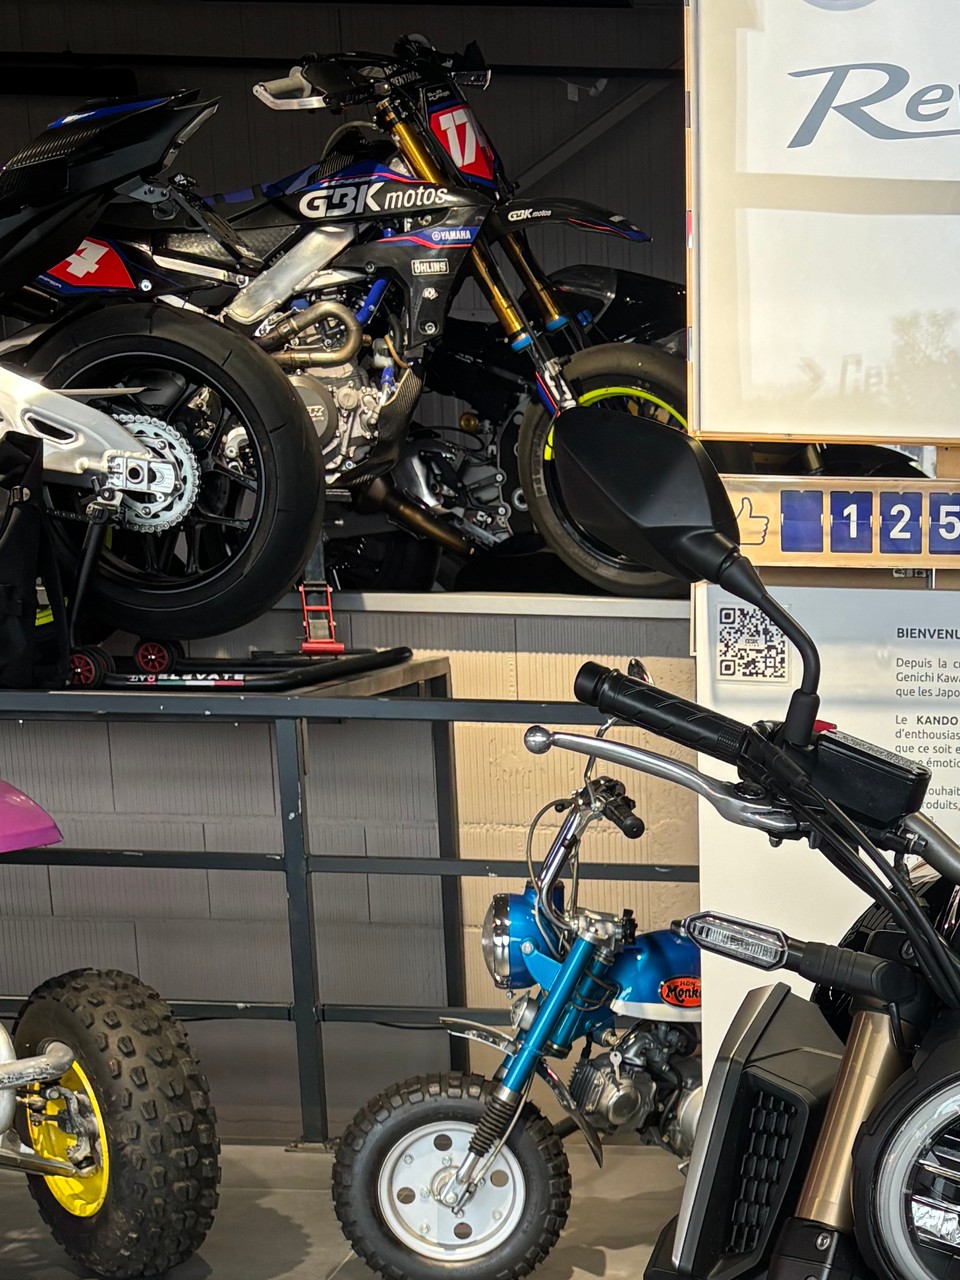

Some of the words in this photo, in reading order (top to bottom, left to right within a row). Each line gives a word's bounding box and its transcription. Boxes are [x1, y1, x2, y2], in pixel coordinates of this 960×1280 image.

[299, 181, 386, 219] GBK
[384, 186, 449, 210] motos
[507, 208, 533, 221] GBK
[532, 209, 552, 218] motos
[440, 230, 471, 240] YAMAHA
[414, 259, 447, 274] ÖHLINS
[896, 657, 933, 670] Depuis
[938, 657, 947, 669] la
[896, 671, 935, 683] Genichi
[895, 688, 916, 698] que
[918, 686, 933, 697] les
[895, 715, 908, 725] Le
[916, 715, 959, 728] KANDO
[895, 746, 915, 757] que
[917, 745, 930, 754] ce
[932, 744, 952, 755] soit
[922, 800, 960, 811] roduits,
[665, 984, 702, 1004] Monk
